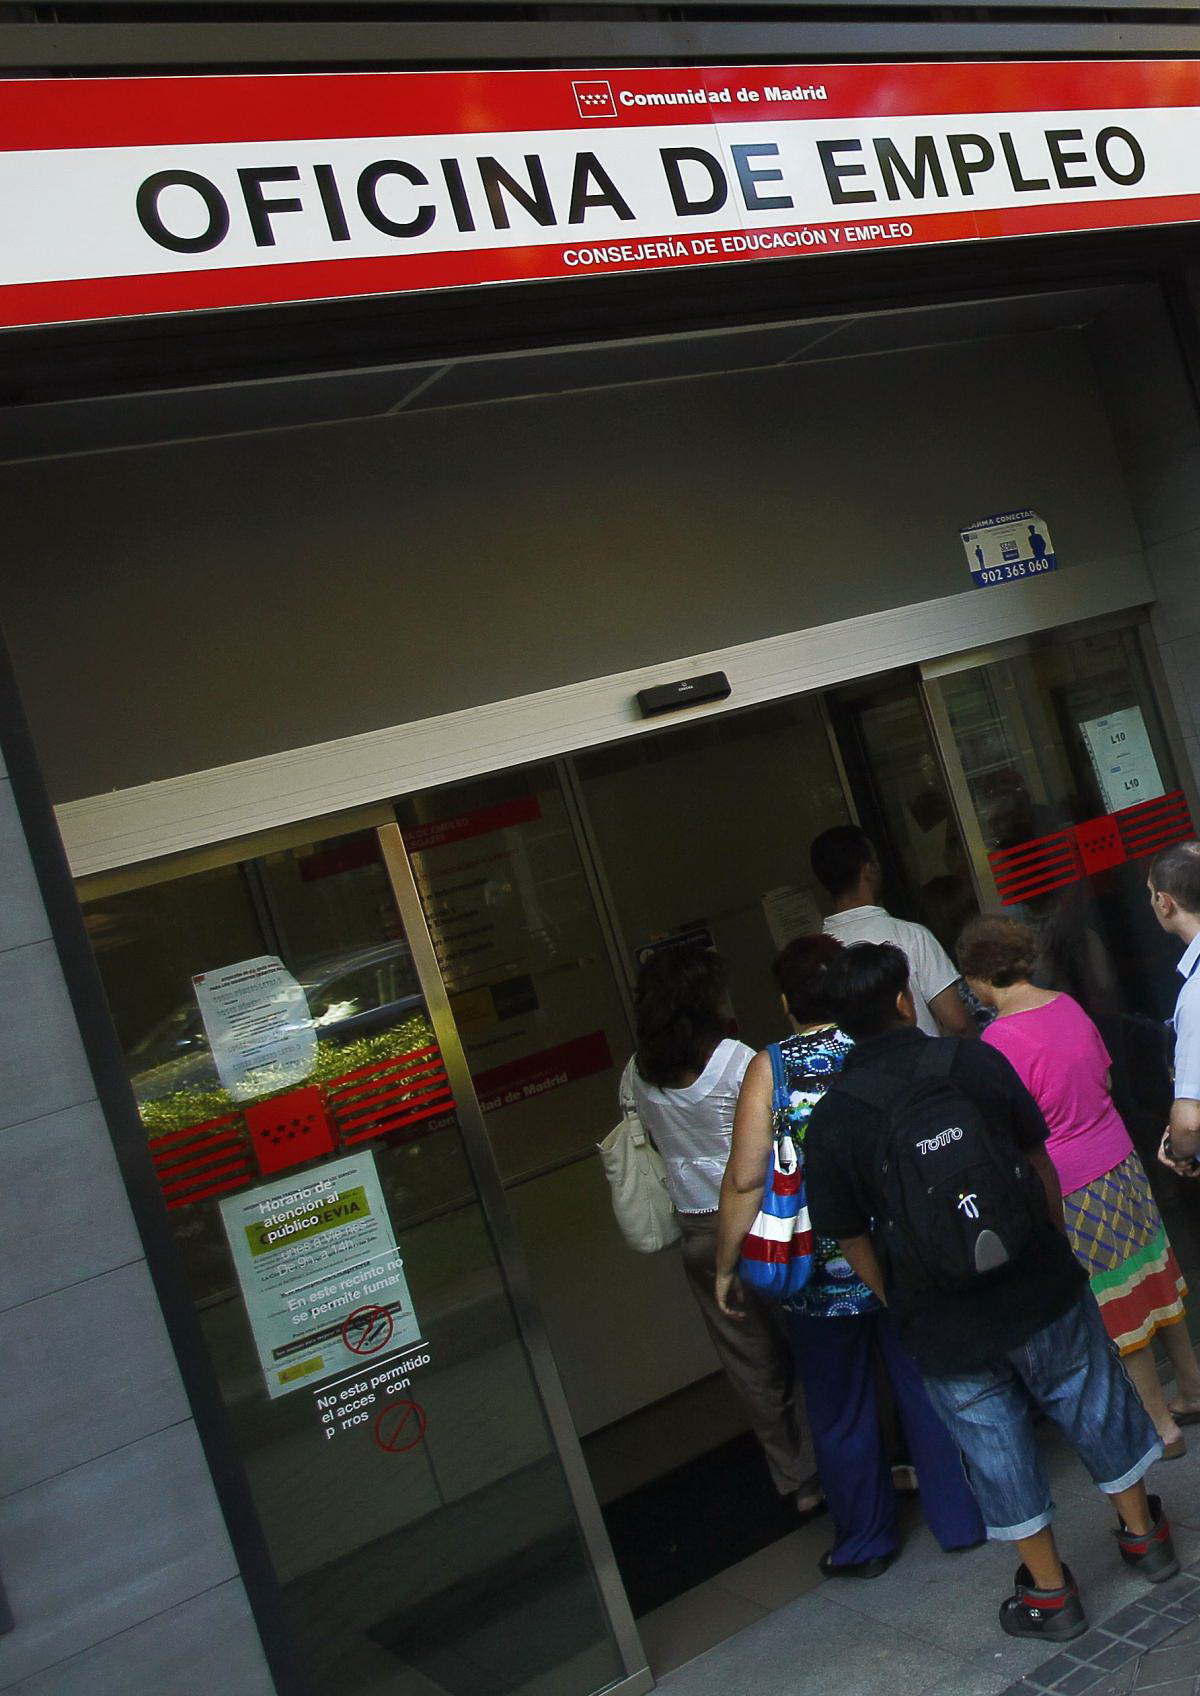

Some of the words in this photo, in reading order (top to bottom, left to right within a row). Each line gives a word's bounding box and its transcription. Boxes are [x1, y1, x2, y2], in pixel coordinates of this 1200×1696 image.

[619, 88, 731, 107] Comunidad
[736, 87, 760, 102] de
[763, 85, 828, 102] Madrid
[135, 151, 637, 254] OFICINA
[659, 142, 795, 217] DE
[816, 126, 1147, 205] EMPLEO
[563, 237, 689, 267] CONSEJERÍA
[692, 238, 719, 256] DE
[723, 226, 828, 254] EDUCACIÓN
[828, 228, 842, 244] Y
[844, 222, 914, 243] EMPLEO
[981, 569, 1003, 584] 902
[1005, 563, 1026, 578] 365
[1028, 558, 1049, 573] 060
[916, 1127, 963, 1155] TOTTO
[258, 1187, 312, 1214] Horario
[315, 1180, 333, 1194] de
[263, 1197, 324, 1228] atención
[327, 1190, 340, 1205] al
[267, 1214, 319, 1243] público
[280, 1240, 312, 1260] unes
[287, 1296, 307, 1312] En
[309, 1285, 337, 1303] este
[340, 1266, 384, 1290] recinto
[387, 1258, 404, 1271] no
[292, 1311, 309, 1325] se
[311, 1289, 361, 1319] permite
[363, 1273, 400, 1296] fumar
[317, 1395, 337, 1410] No
[340, 1382, 368, 1400] esta
[370, 1354, 431, 1389] permitido
[321, 1410, 335, 1423] el
[337, 1393, 376, 1417] acces
[386, 1378, 411, 1394] con
[325, 1411, 369, 1440] prros
